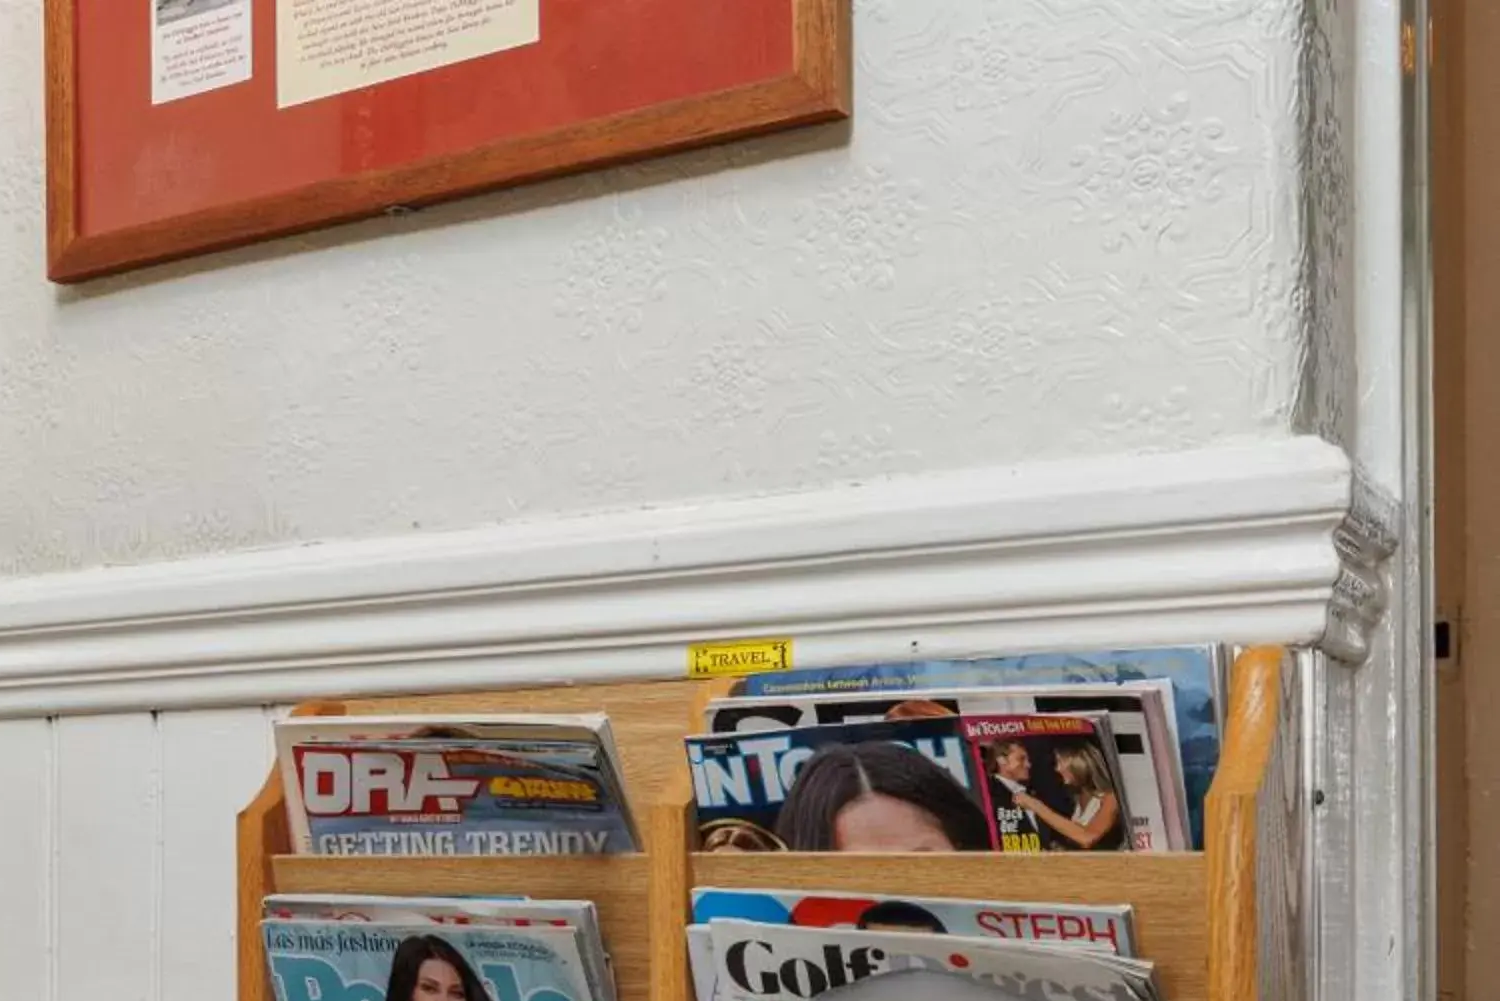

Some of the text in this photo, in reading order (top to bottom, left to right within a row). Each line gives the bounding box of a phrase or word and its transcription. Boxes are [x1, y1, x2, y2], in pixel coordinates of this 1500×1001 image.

[709, 651, 771, 668] TRAVEL
[320, 831, 609, 856] GETTING TRENDY
[1002, 833, 1040, 856] BRAD
[727, 939, 887, 999] Golf
